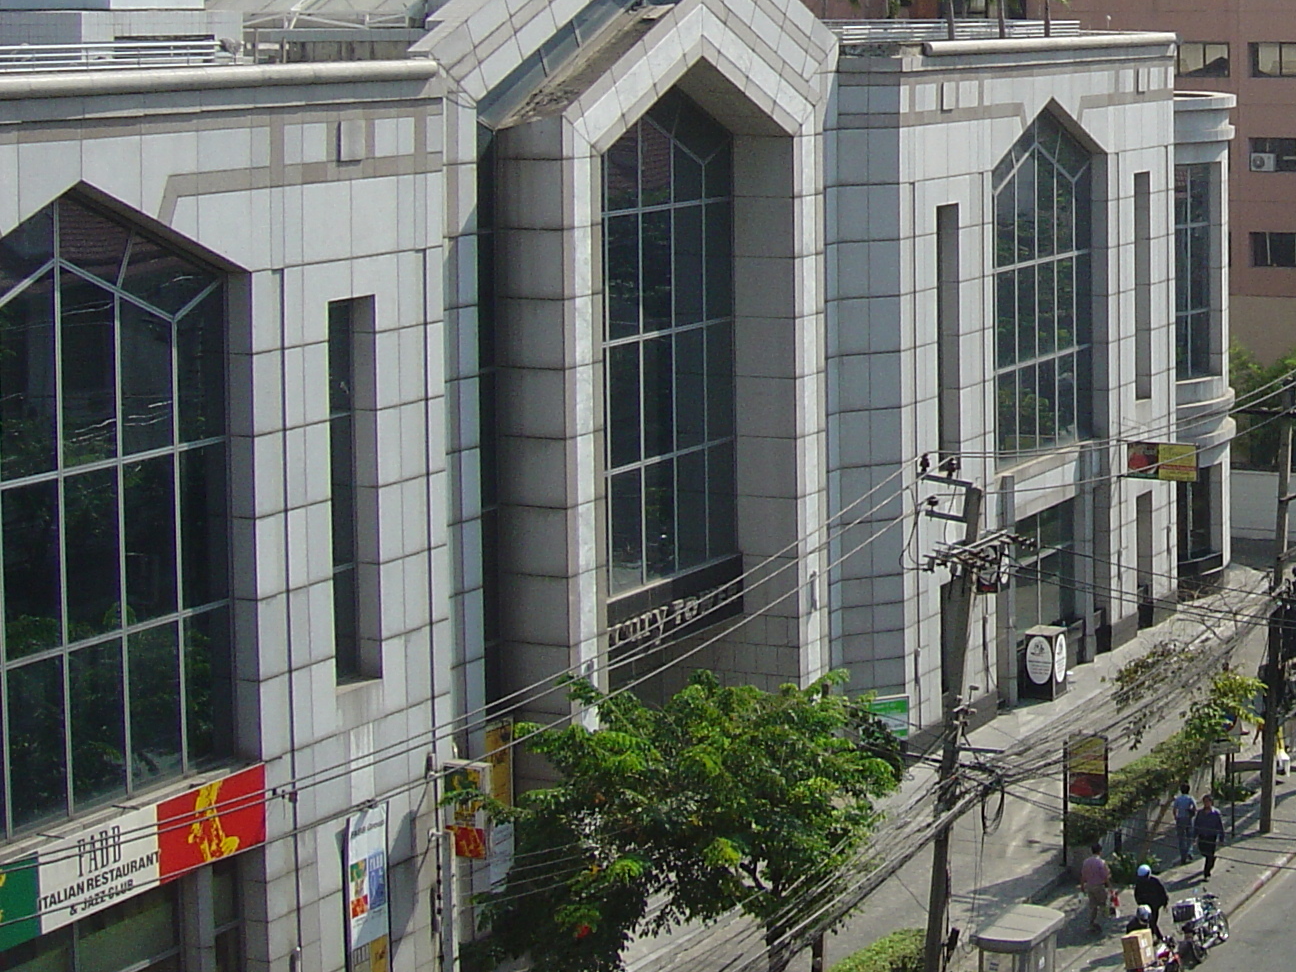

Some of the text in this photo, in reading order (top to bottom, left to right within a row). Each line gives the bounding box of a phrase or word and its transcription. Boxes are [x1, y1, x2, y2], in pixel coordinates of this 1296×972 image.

[38, 850, 160, 911] ITALIAN RESTAURANT
[69, 904, 78, 916] &
[108, 879, 134, 901] CLUB
